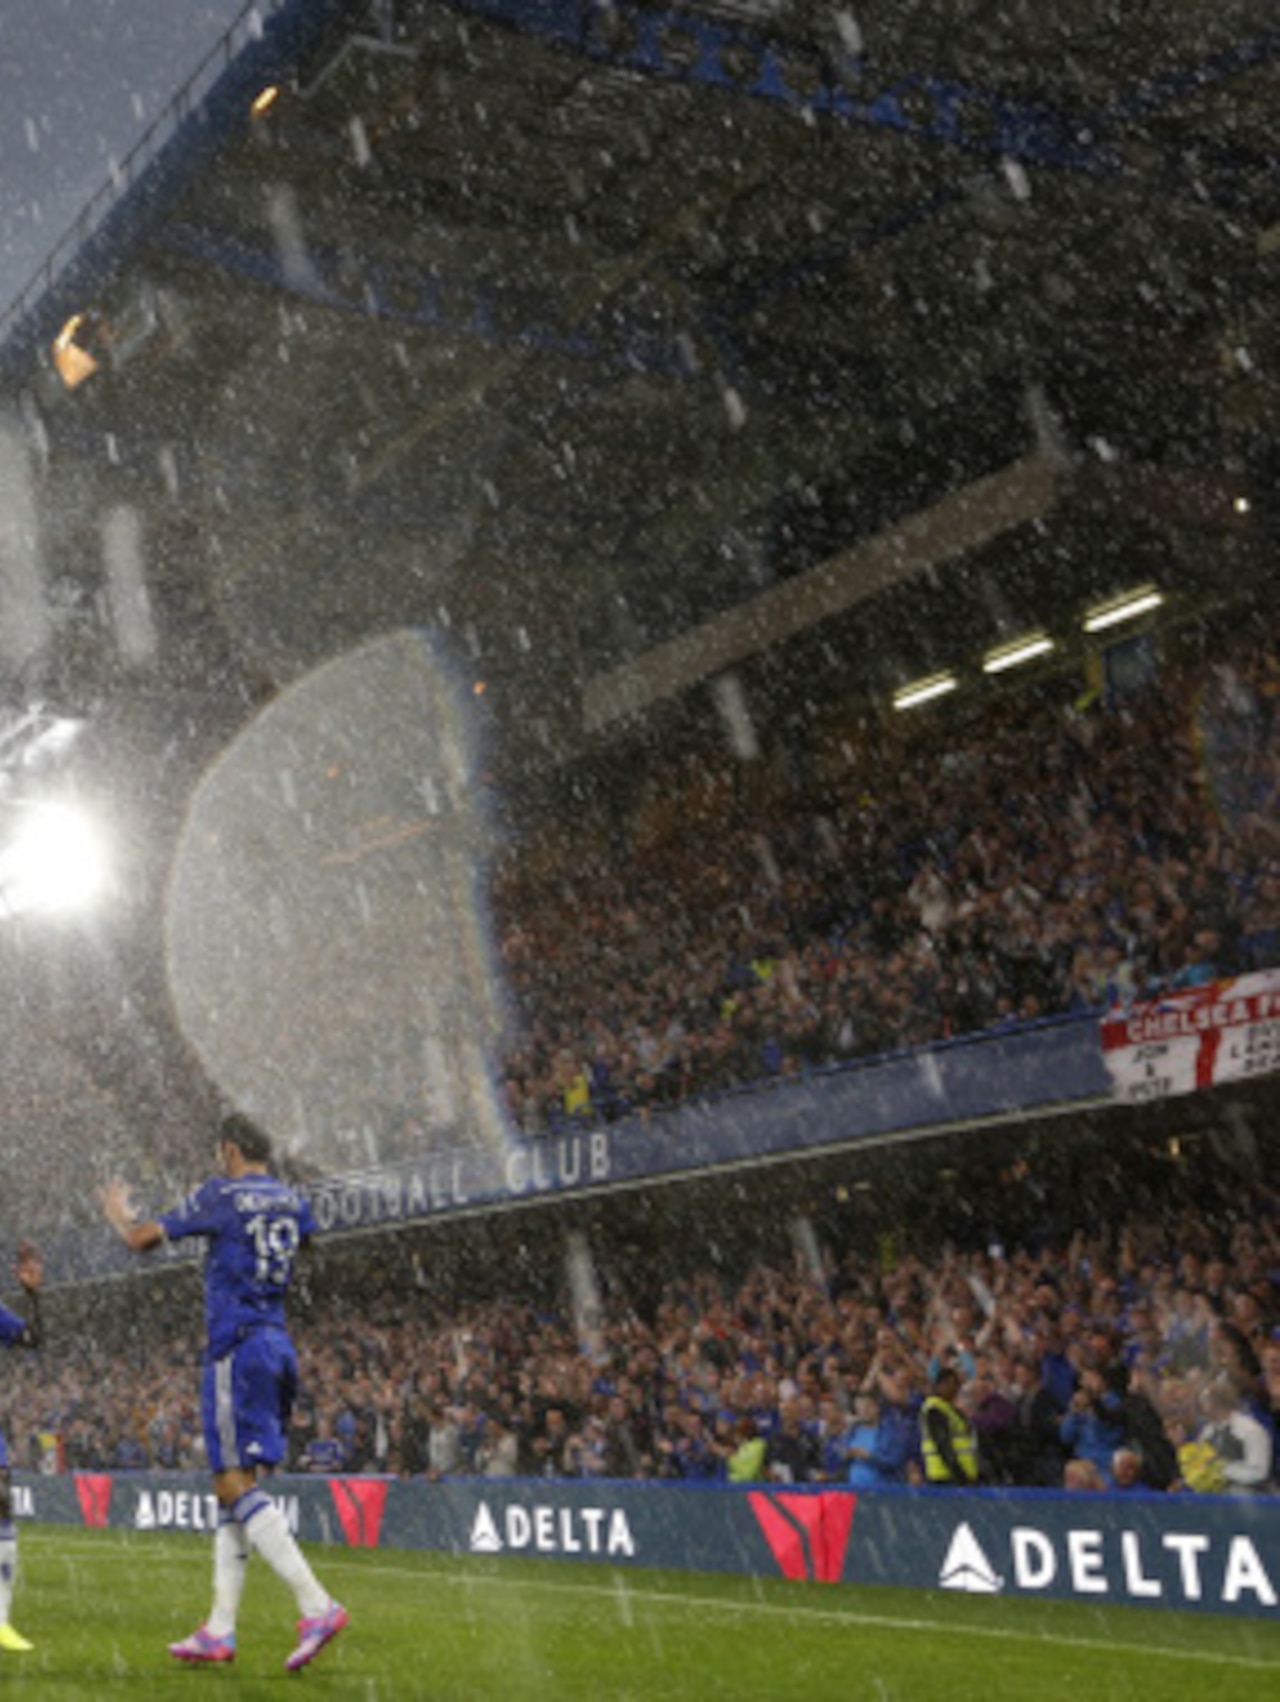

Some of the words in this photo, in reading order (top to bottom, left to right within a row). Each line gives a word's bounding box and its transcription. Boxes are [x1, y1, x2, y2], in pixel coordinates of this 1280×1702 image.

[308, 1160, 470, 1230] OOTBALL
[506, 1132, 610, 1195] CLUB
[505, 1504, 635, 1557] DELTA
[1010, 1526, 1278, 1606] DELTA
